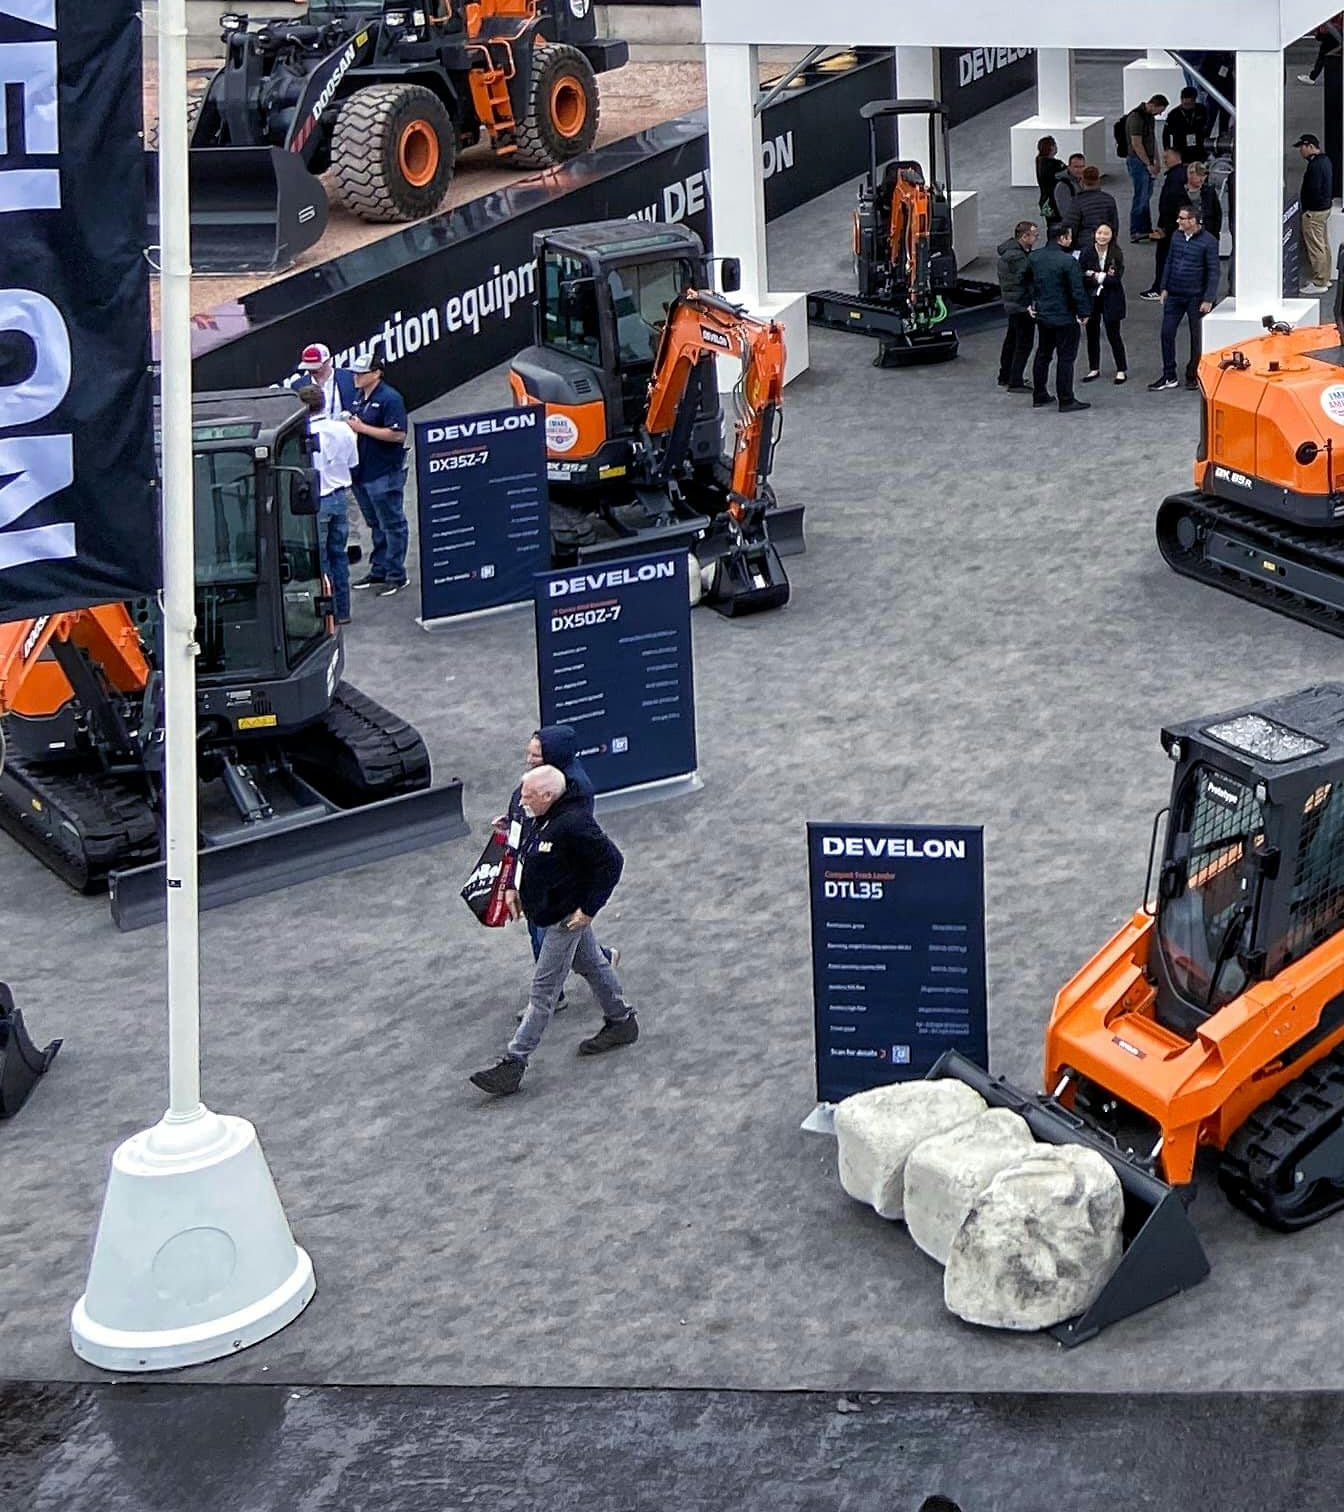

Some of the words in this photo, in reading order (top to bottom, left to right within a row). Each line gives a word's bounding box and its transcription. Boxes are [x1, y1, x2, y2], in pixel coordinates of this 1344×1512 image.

[959, 46, 1034, 87] DEVELO
[311, 46, 357, 120] DOOSAN
[427, 413, 536, 443] DEVELON
[429, 451, 489, 473] DX35Z-7
[549, 561, 675, 598] DEVELON
[551, 606, 622, 633] DX50Z-7
[823, 837, 965, 858] DEVELON
[824, 882, 883, 899] DTL35
